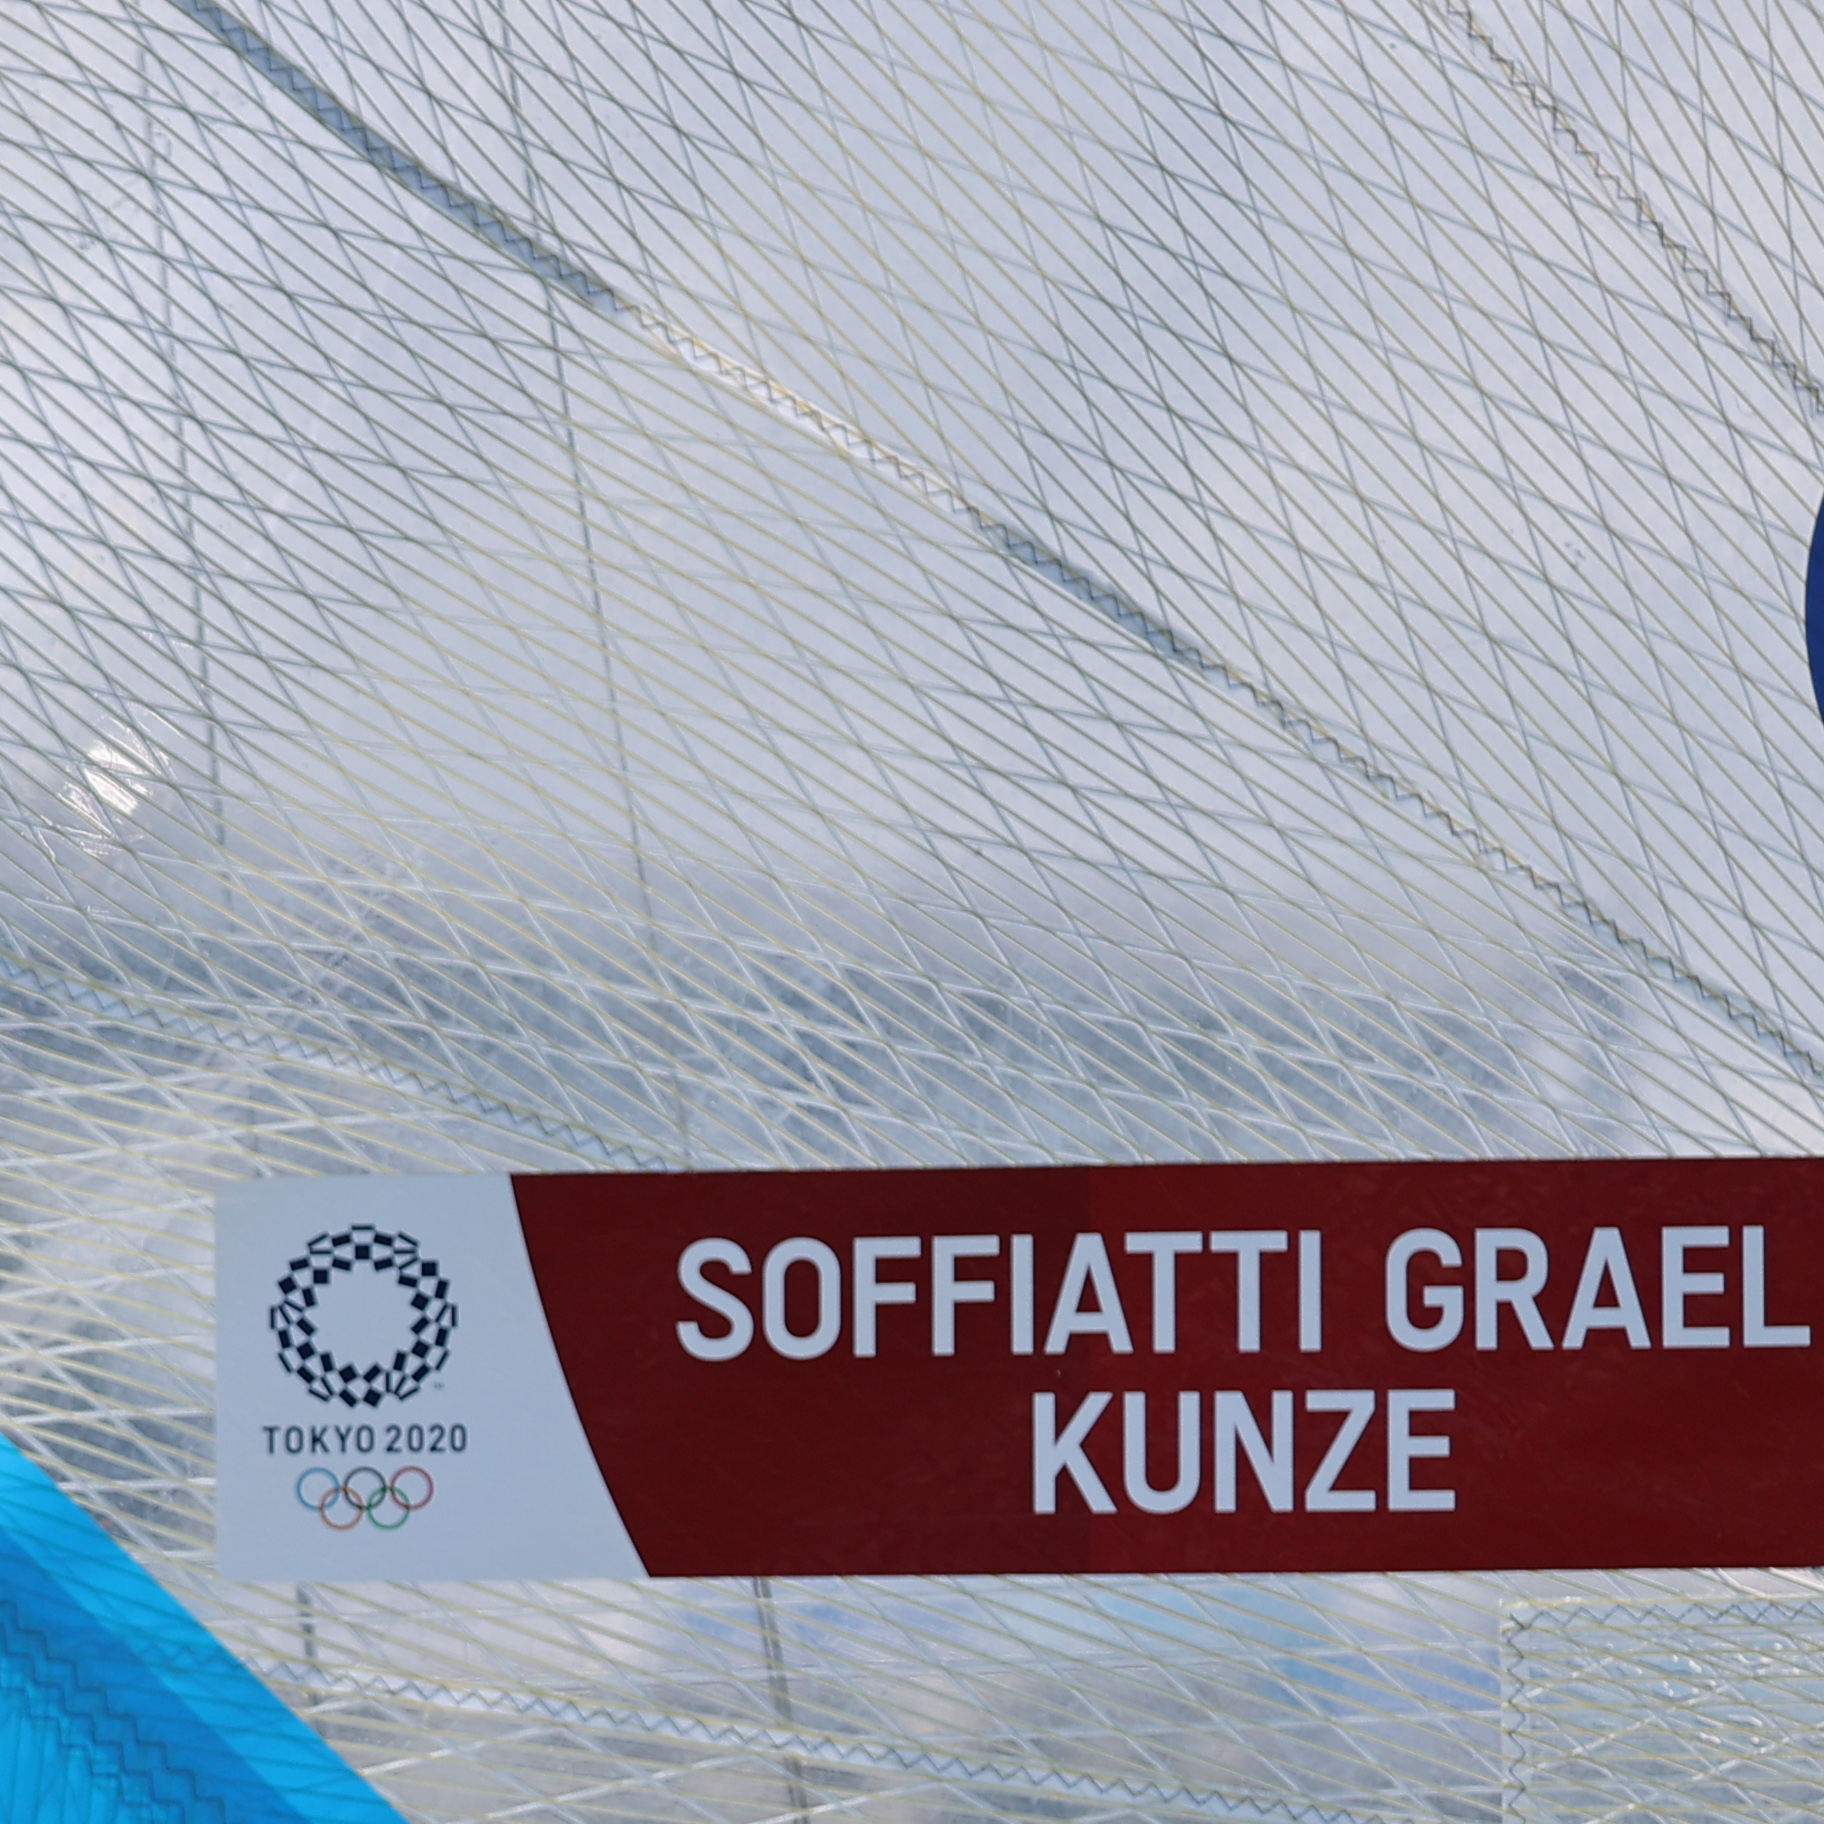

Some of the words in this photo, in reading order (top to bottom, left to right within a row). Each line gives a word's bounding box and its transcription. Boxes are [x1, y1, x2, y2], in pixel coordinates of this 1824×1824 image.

[676, 1230, 1322, 1361] SOFFIATTI
[1385, 1225, 1811, 1352] GRAEL
[262, 1424, 375, 1455] TOKYO
[385, 1423, 468, 1454] 2020
[1032, 1388, 1456, 1514] KUNZE
